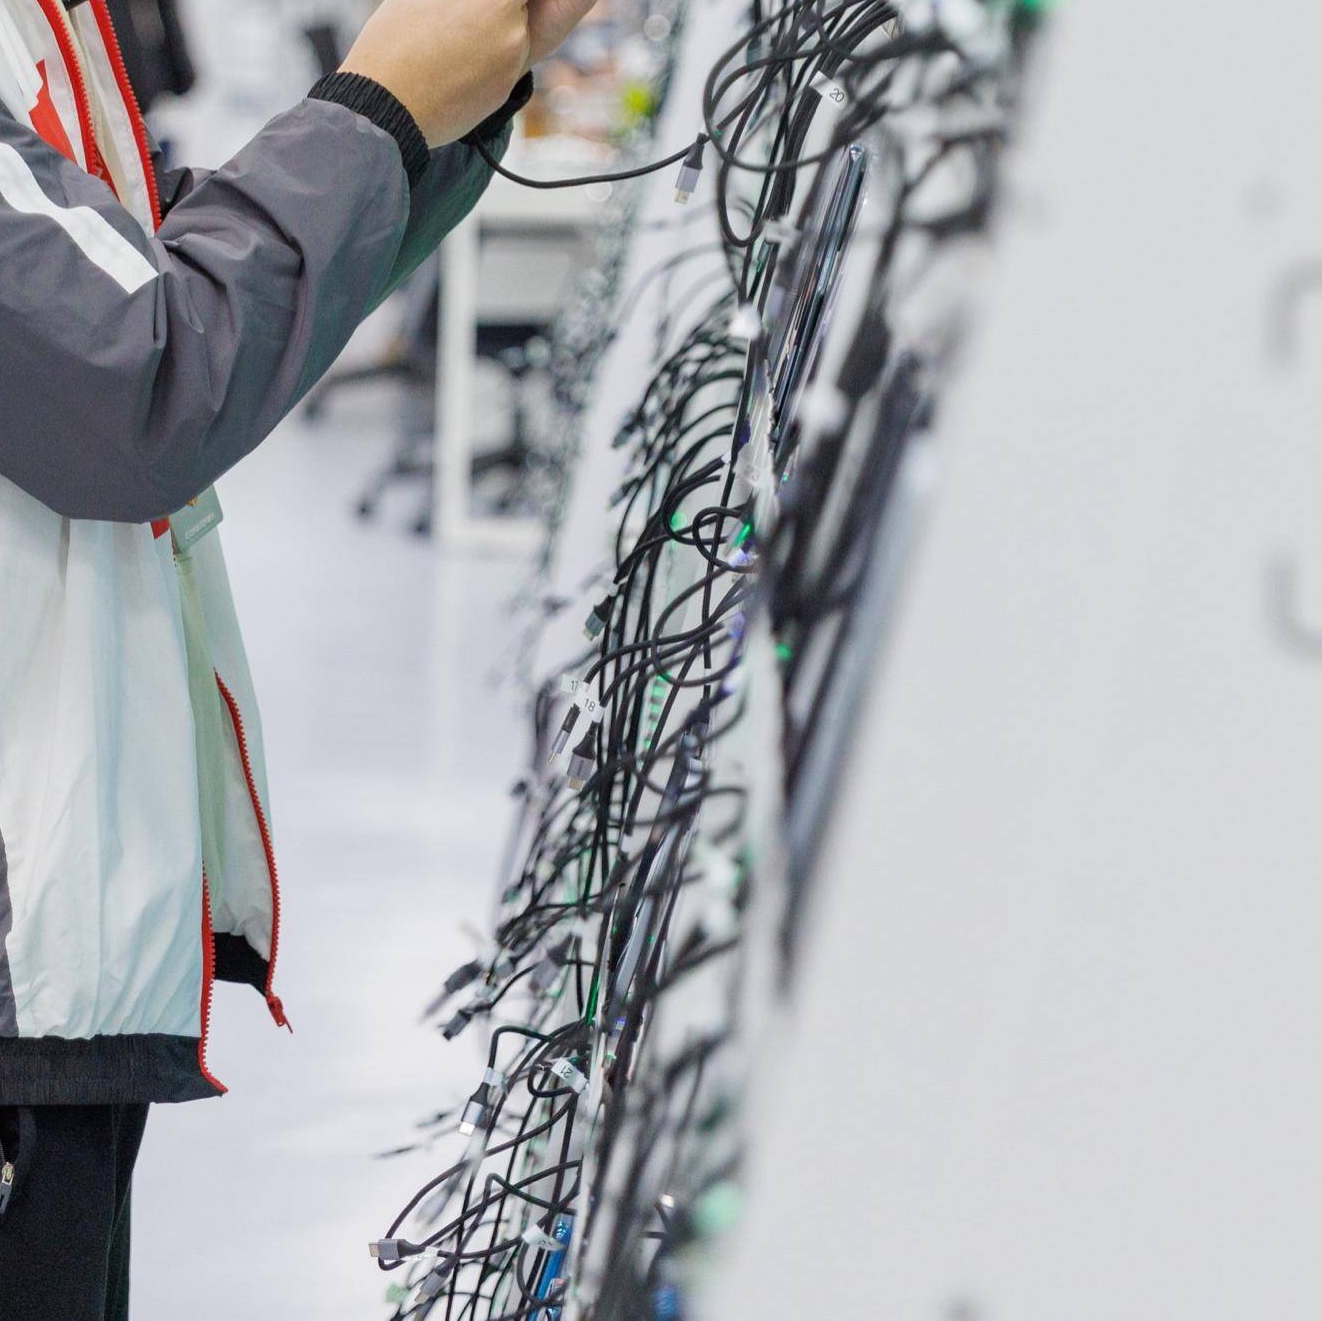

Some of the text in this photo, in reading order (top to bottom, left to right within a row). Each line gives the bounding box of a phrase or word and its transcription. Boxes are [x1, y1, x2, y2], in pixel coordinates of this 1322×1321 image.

[829, 88, 845, 102] 20
[584, 698, 596, 712] 18
[560, 1065, 573, 1078] 21
